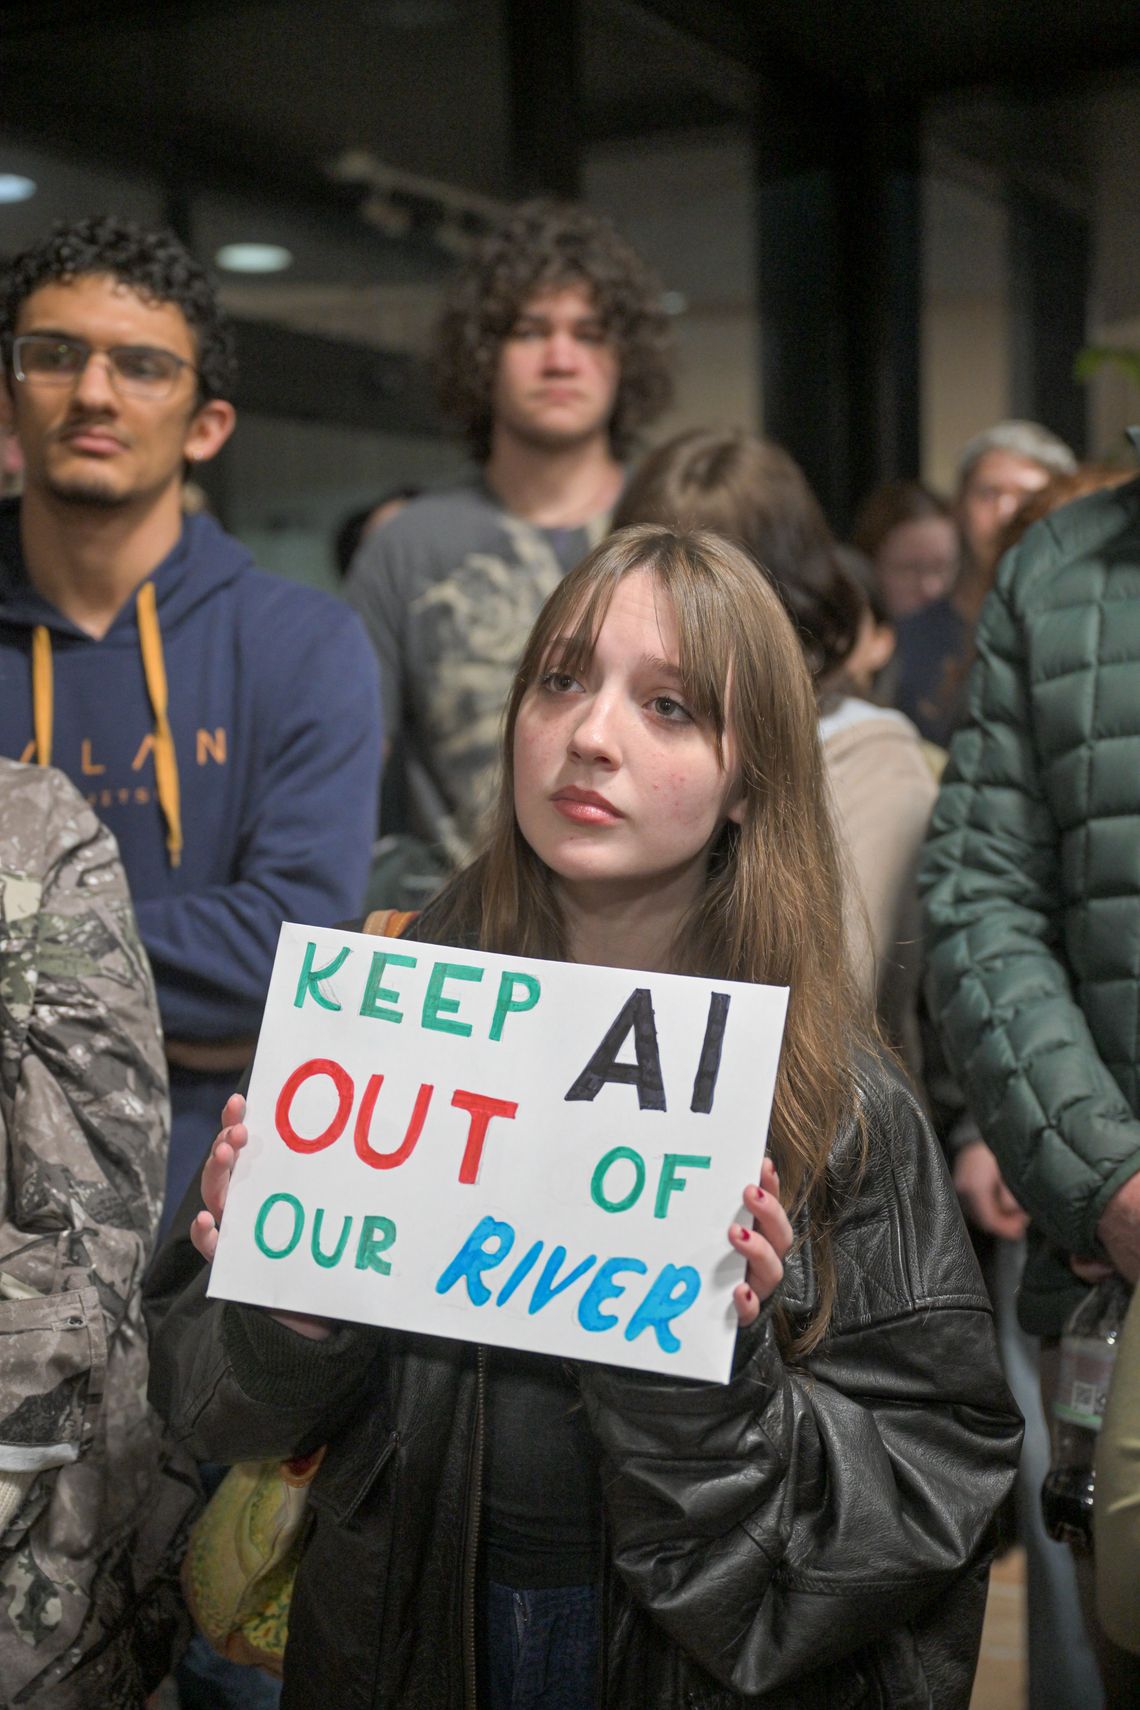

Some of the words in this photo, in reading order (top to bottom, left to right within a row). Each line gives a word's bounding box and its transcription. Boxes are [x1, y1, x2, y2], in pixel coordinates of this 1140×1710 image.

[293, 941, 542, 1042] KEEP
[564, 988, 731, 1114] AI
[274, 1057, 519, 1185] OUT
[590, 1145, 712, 1220] OF
[254, 1192, 398, 1276] OUR
[435, 1215, 702, 1354] RIVER
